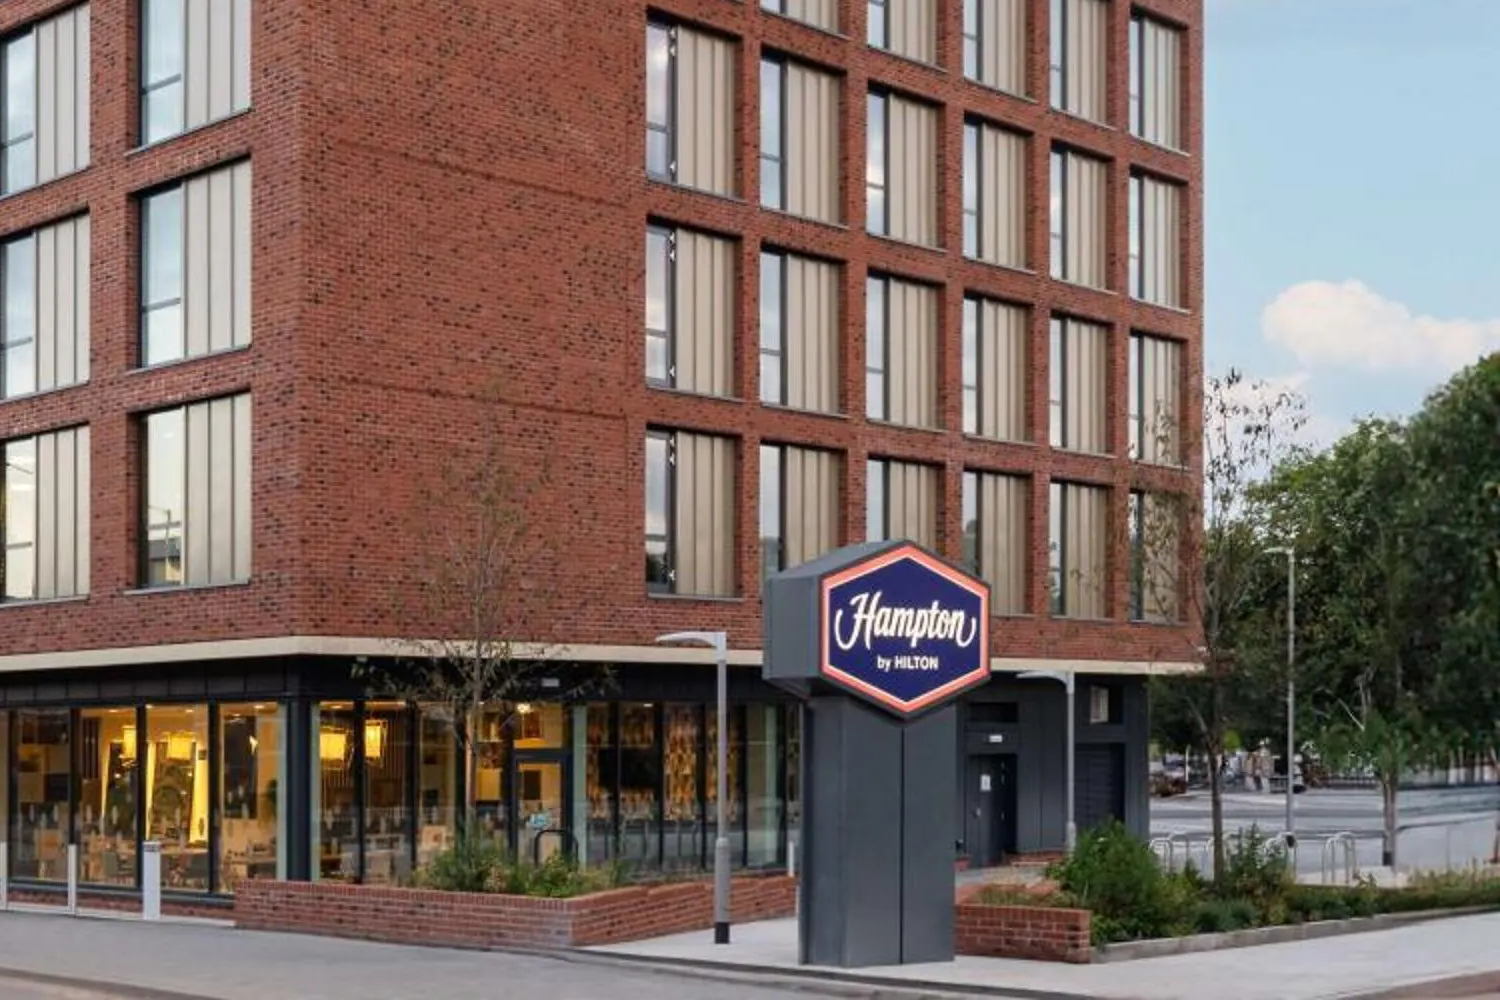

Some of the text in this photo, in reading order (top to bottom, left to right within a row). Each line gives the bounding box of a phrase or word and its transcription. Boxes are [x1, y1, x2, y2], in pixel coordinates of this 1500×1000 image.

[835, 591, 976, 650] Hampton
[877, 655, 939, 672] by HILTON
